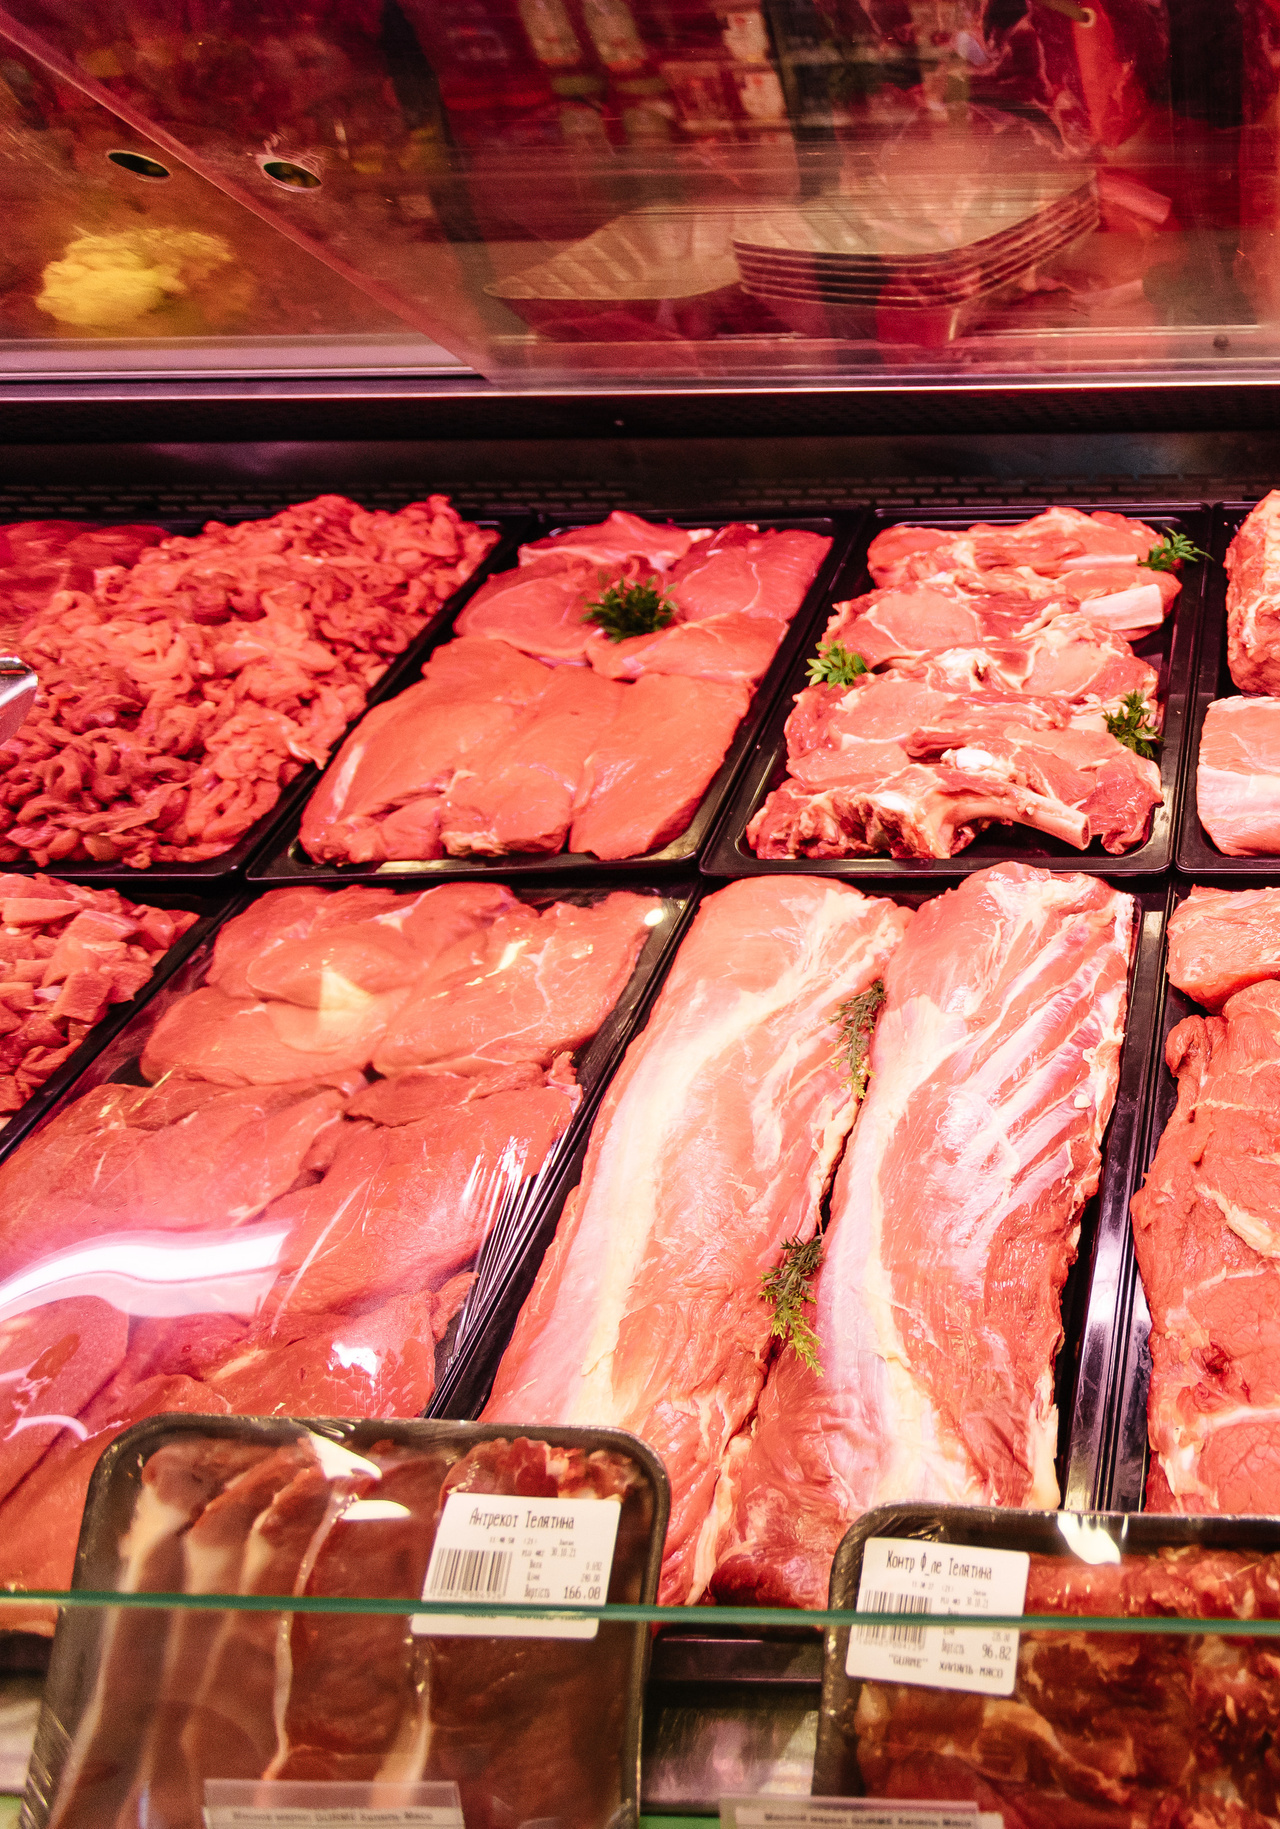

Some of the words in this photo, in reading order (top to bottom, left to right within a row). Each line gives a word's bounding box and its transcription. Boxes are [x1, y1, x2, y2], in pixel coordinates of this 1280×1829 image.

[469, 1507, 518, 1529] Антрекот
[525, 1510, 575, 1530] Телятина
[886, 1550, 915, 1573] Контр
[949, 1557, 992, 1580] Телятина
[564, 1586, 601, 1600] 166.08
[982, 1643, 1012, 1661] 96.82
